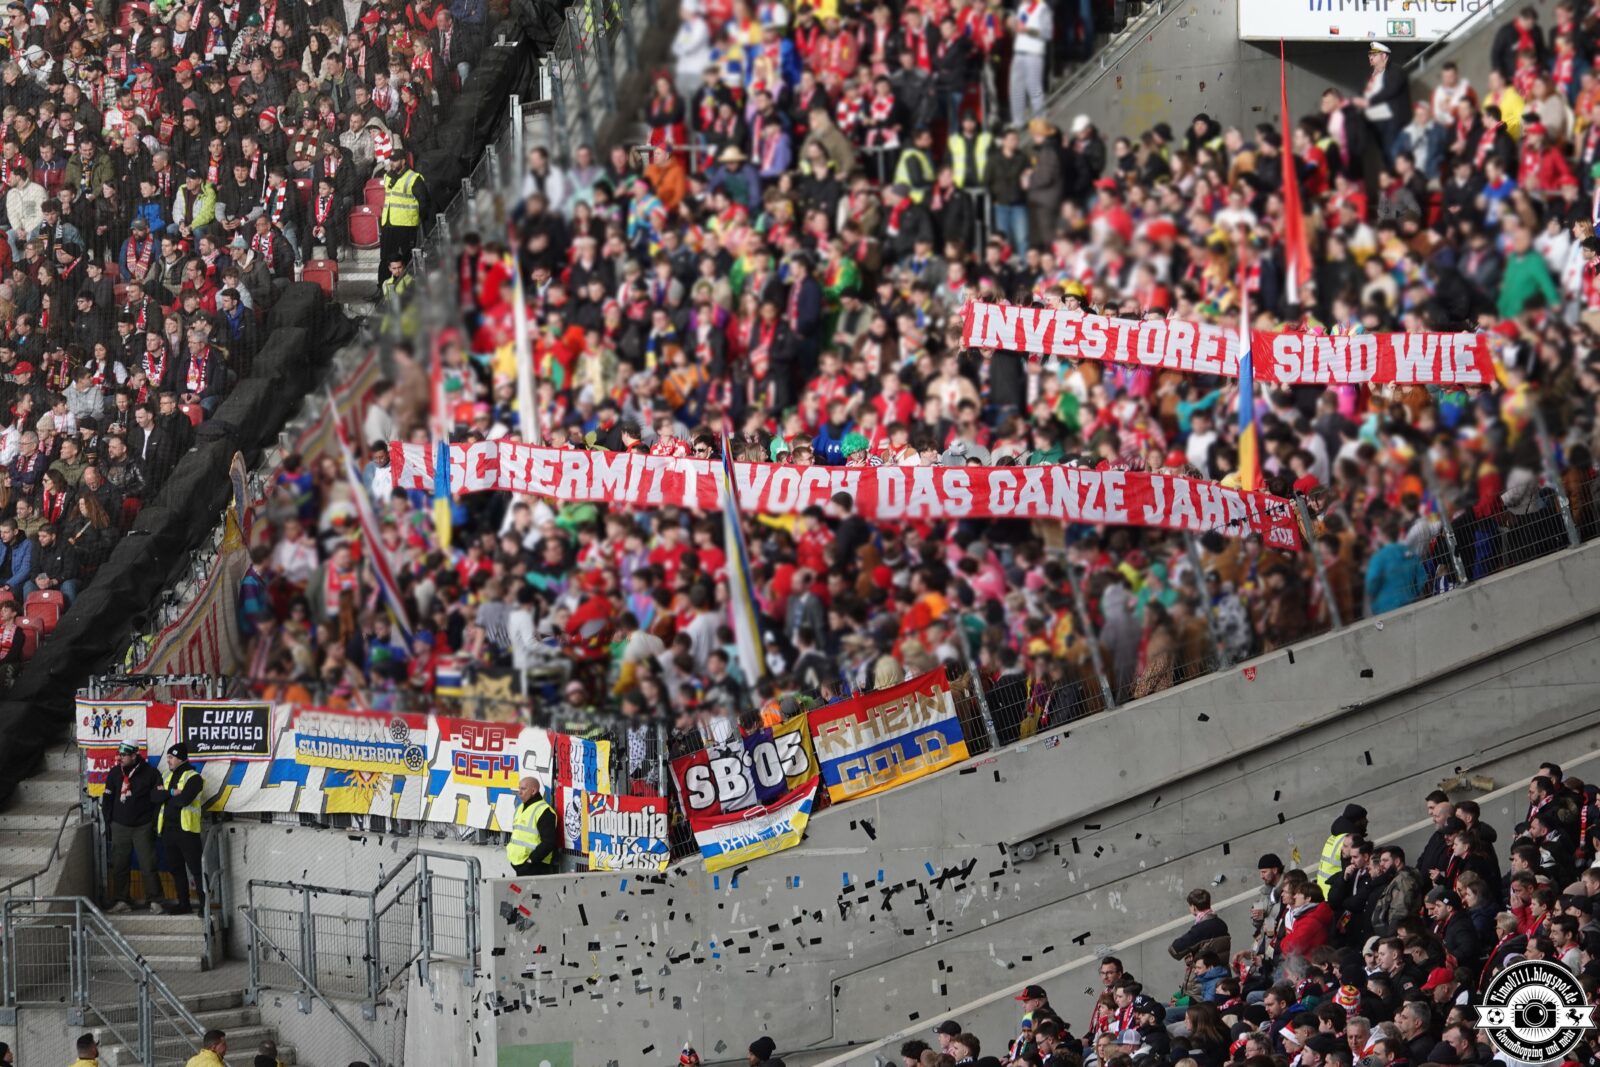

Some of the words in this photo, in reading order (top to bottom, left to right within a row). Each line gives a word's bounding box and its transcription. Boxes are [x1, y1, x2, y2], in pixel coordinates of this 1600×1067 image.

[1272, 333, 1378, 383] SIND
[1391, 333, 1482, 383] WIE
[876, 466, 973, 518] DAS
[988, 466, 1128, 523] GANZE
[202, 710, 254, 724] CURVA
[816, 684, 947, 754] RHEIN
[455, 752, 516, 780] CIETY
[836, 730, 952, 795] GOLD
